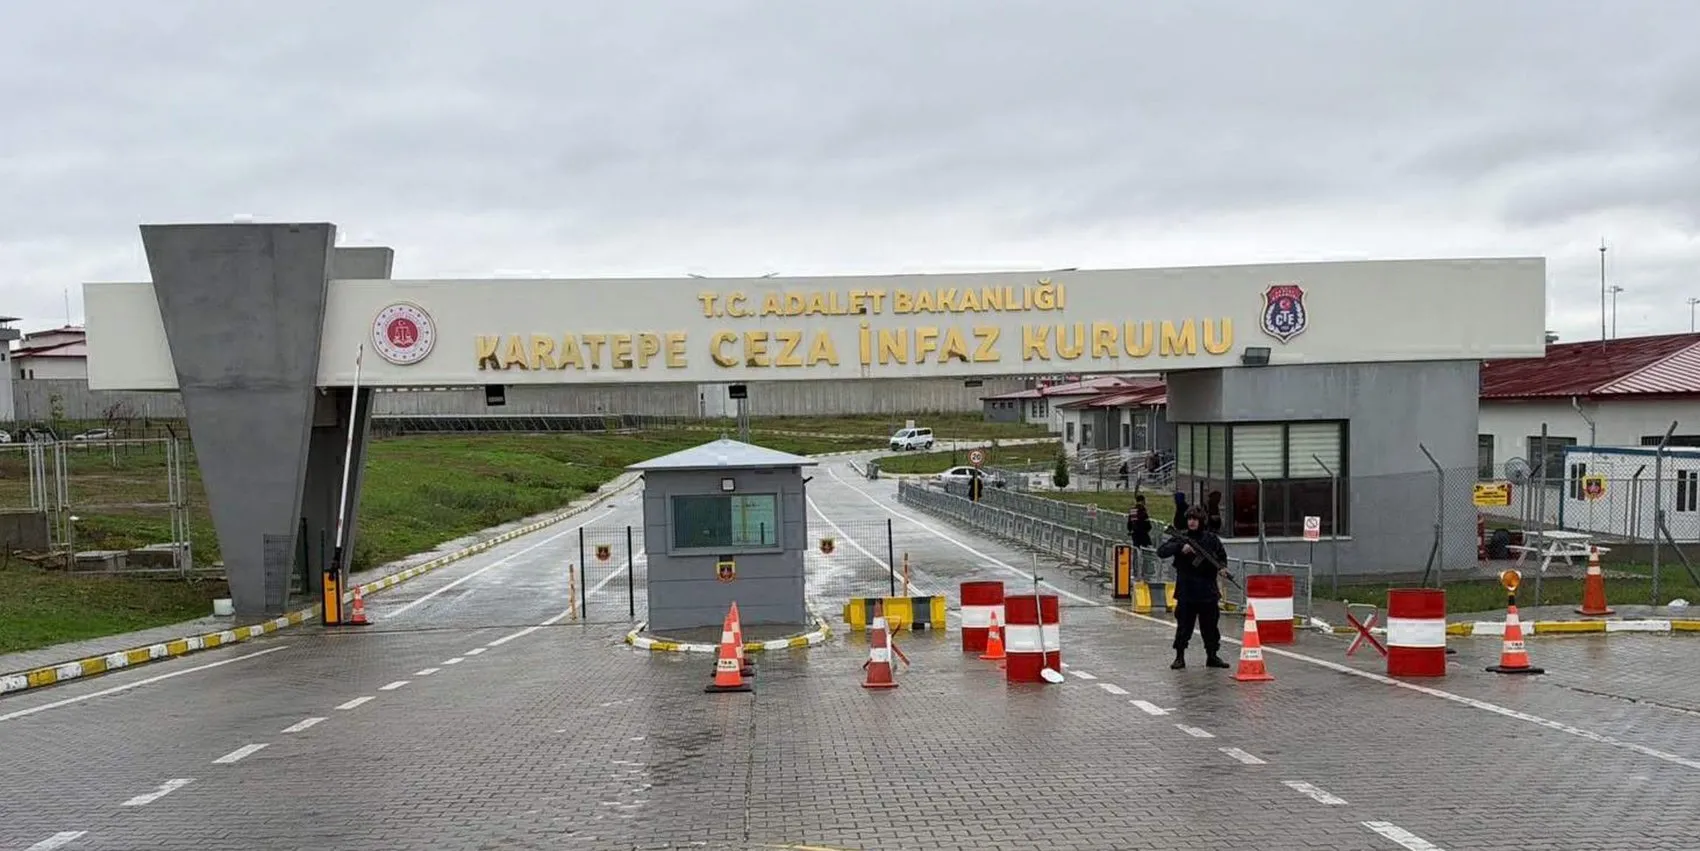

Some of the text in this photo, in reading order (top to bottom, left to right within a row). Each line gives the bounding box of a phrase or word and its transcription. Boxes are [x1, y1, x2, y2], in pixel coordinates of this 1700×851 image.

[698, 278, 1066, 318] T.C. ADALET BAKANLIĞI
[1275, 310, 1295, 326] CTE
[476, 316, 1235, 371] KARATEPE CEZA İNFAZ KURUMU
